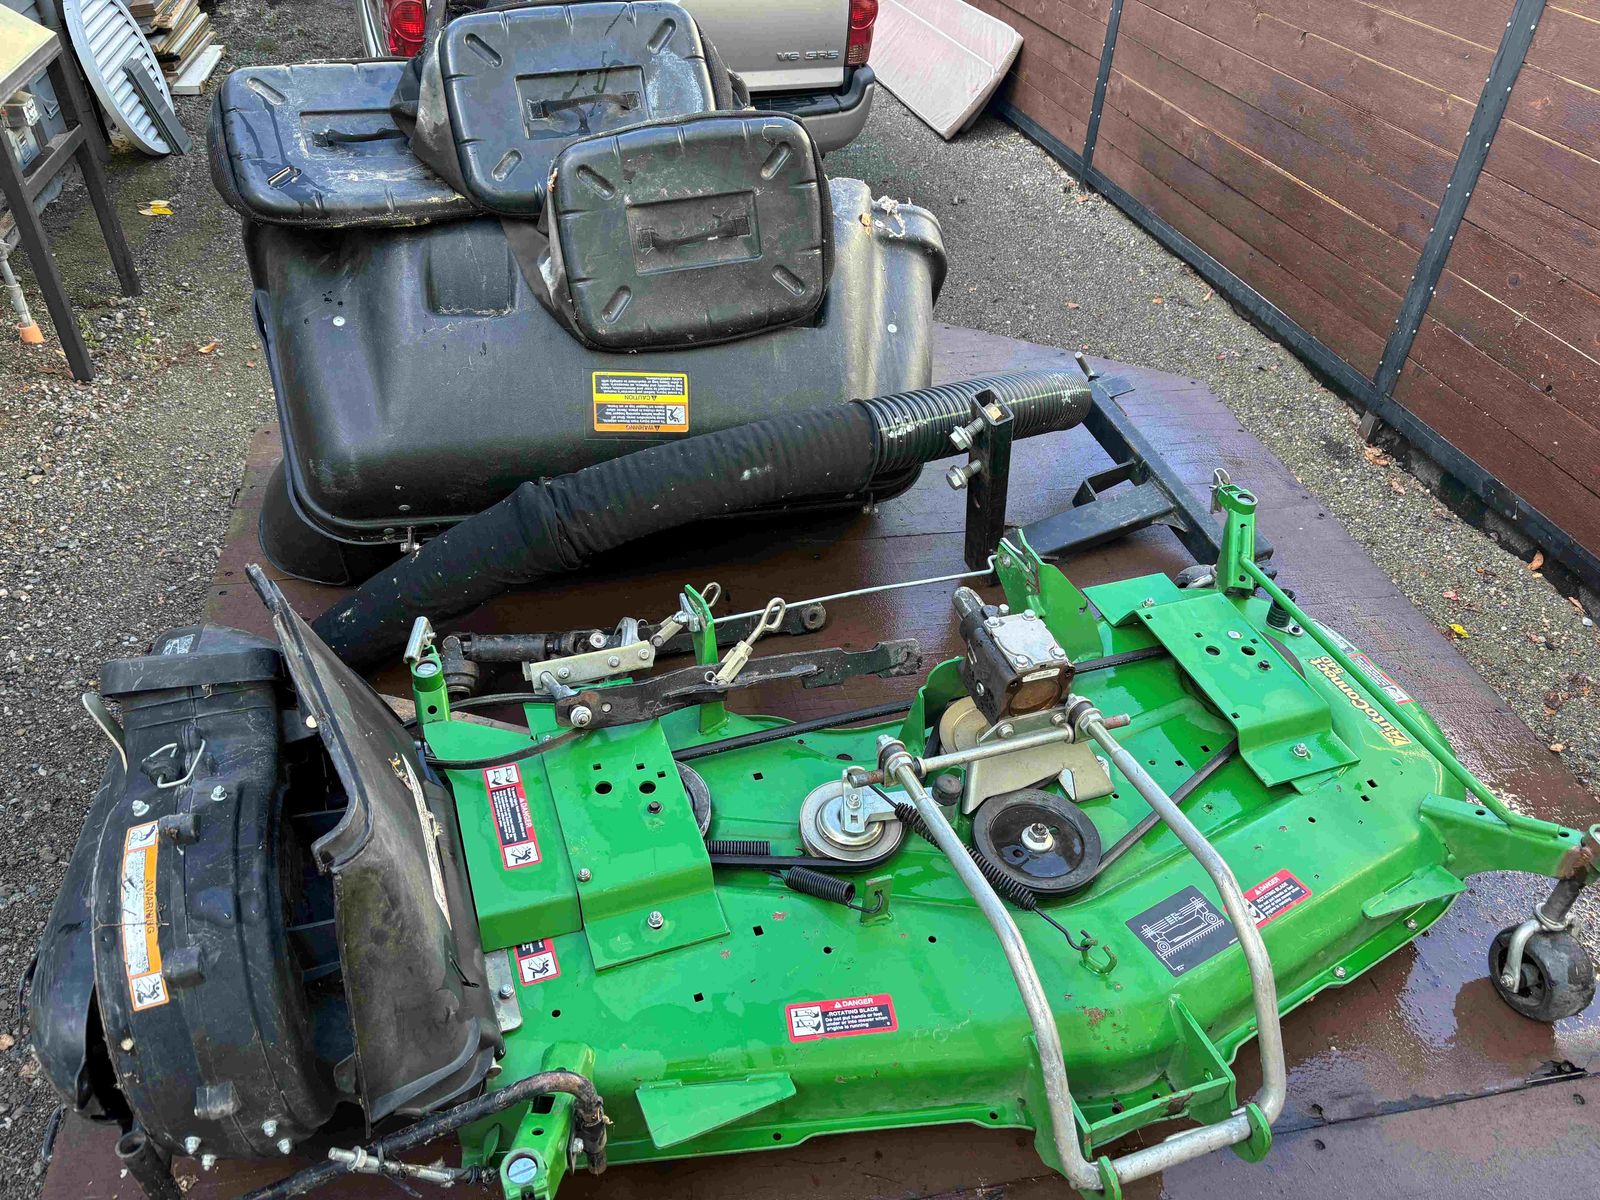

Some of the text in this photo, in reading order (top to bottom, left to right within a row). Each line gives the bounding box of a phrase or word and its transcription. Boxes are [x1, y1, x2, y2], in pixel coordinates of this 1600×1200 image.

[776, 51, 800, 61] V6
[1309, 657, 1412, 747] AutoConnect
[520, 802, 533, 828] DANGER
[1258, 876, 1280, 891] DANGER
[842, 998, 874, 1007] DANGER
[829, 1008, 858, 1017] ROTATING
